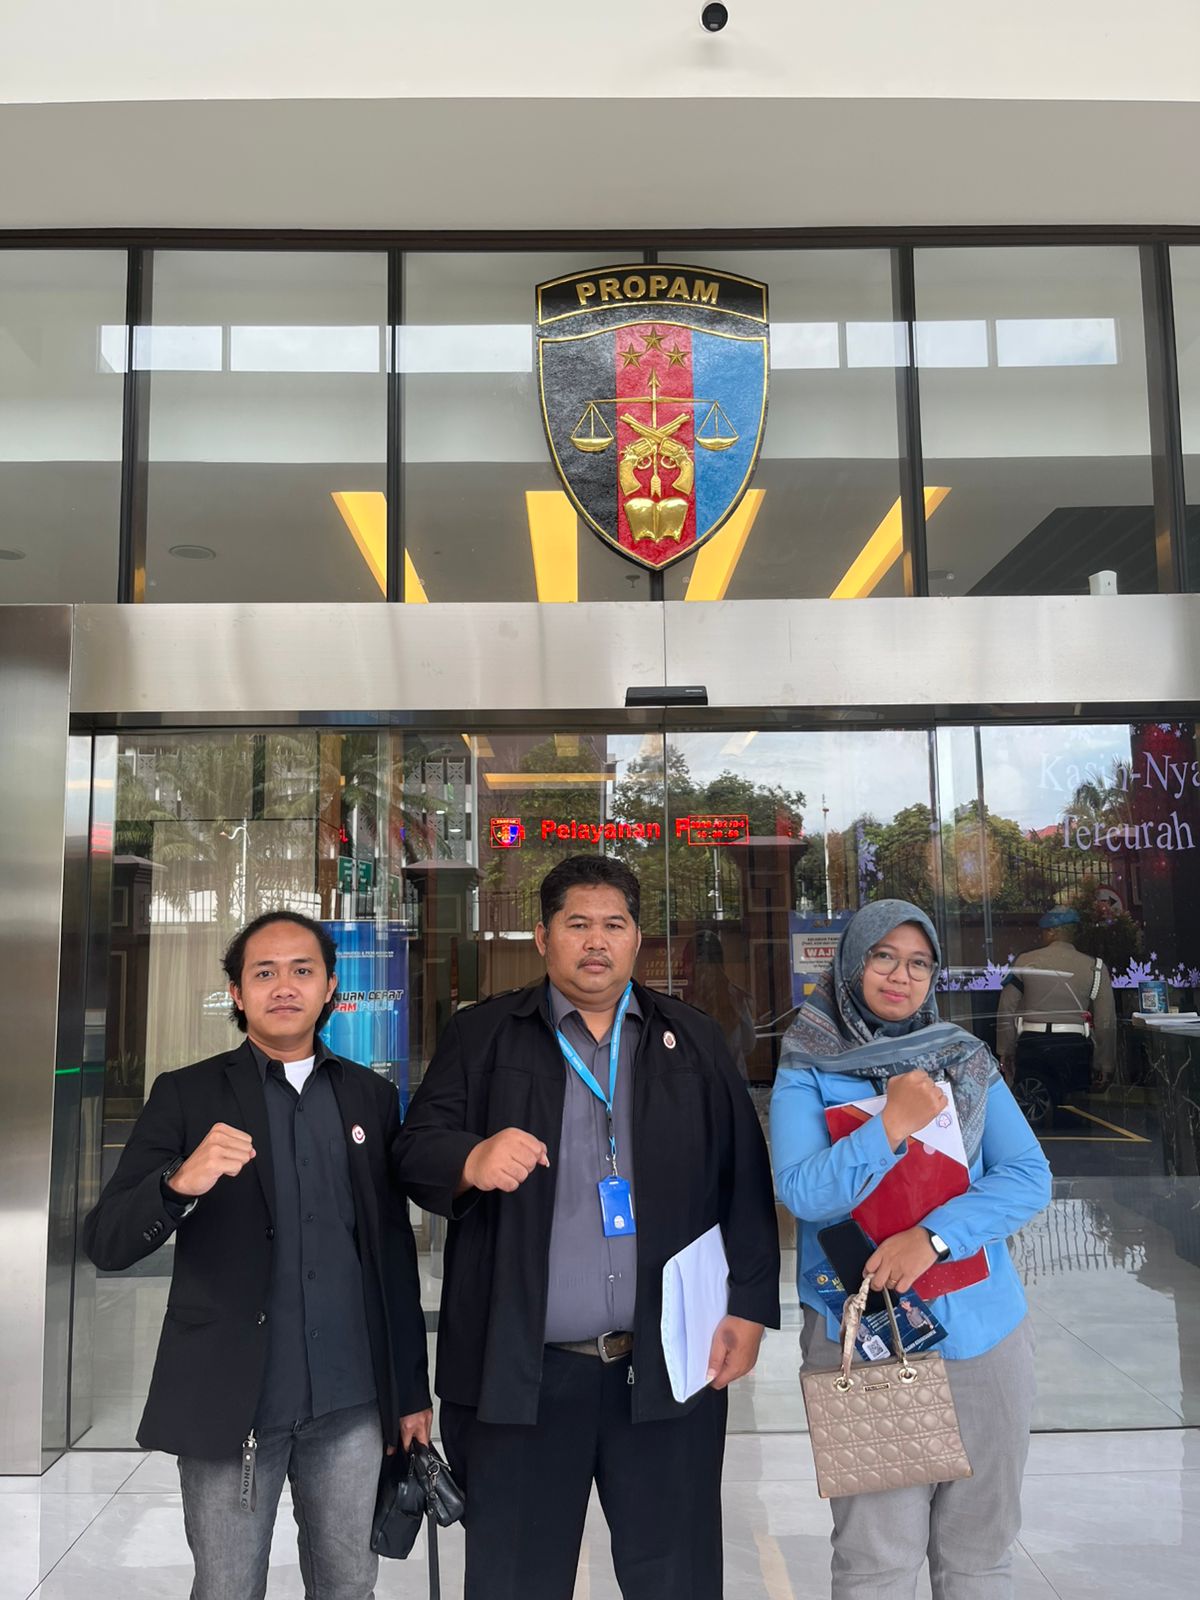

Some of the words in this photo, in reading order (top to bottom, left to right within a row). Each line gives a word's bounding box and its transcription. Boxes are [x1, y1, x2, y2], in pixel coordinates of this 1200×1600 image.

[575, 275, 720, 306] PROPAM
[541, 819, 660, 844] Pelayanan
[1058, 811, 1196, 851] Tercurah
[806, 948, 835, 957] WAJI
